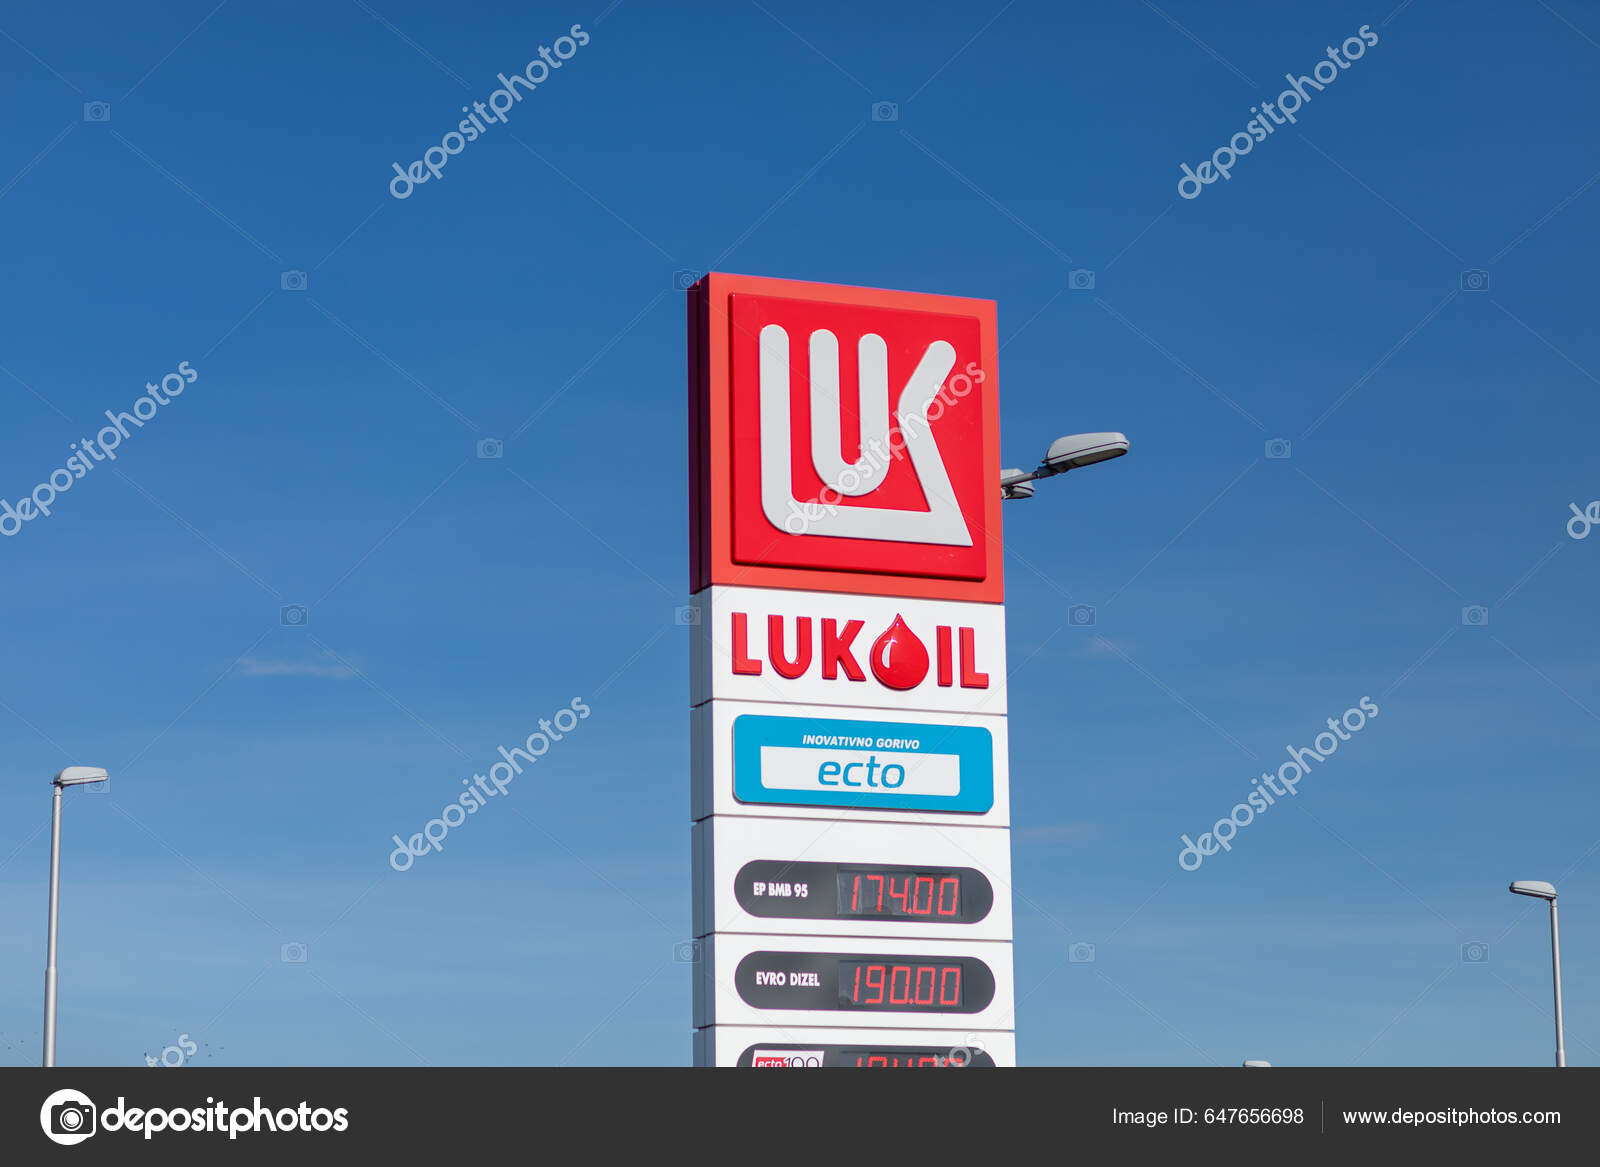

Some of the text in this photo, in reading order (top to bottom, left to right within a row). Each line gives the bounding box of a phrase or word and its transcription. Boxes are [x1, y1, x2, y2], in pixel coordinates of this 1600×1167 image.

[731, 611, 990, 691] LUKOIL
[802, 734, 920, 750] INOVATIVNO GORIVO
[818, 755, 905, 788] ecto
[753, 882, 809, 898] EP BMB 95
[852, 875, 959, 916] 174.00
[756, 971, 821, 987] EVRO DIZEL
[853, 965, 961, 1006] 190.00
